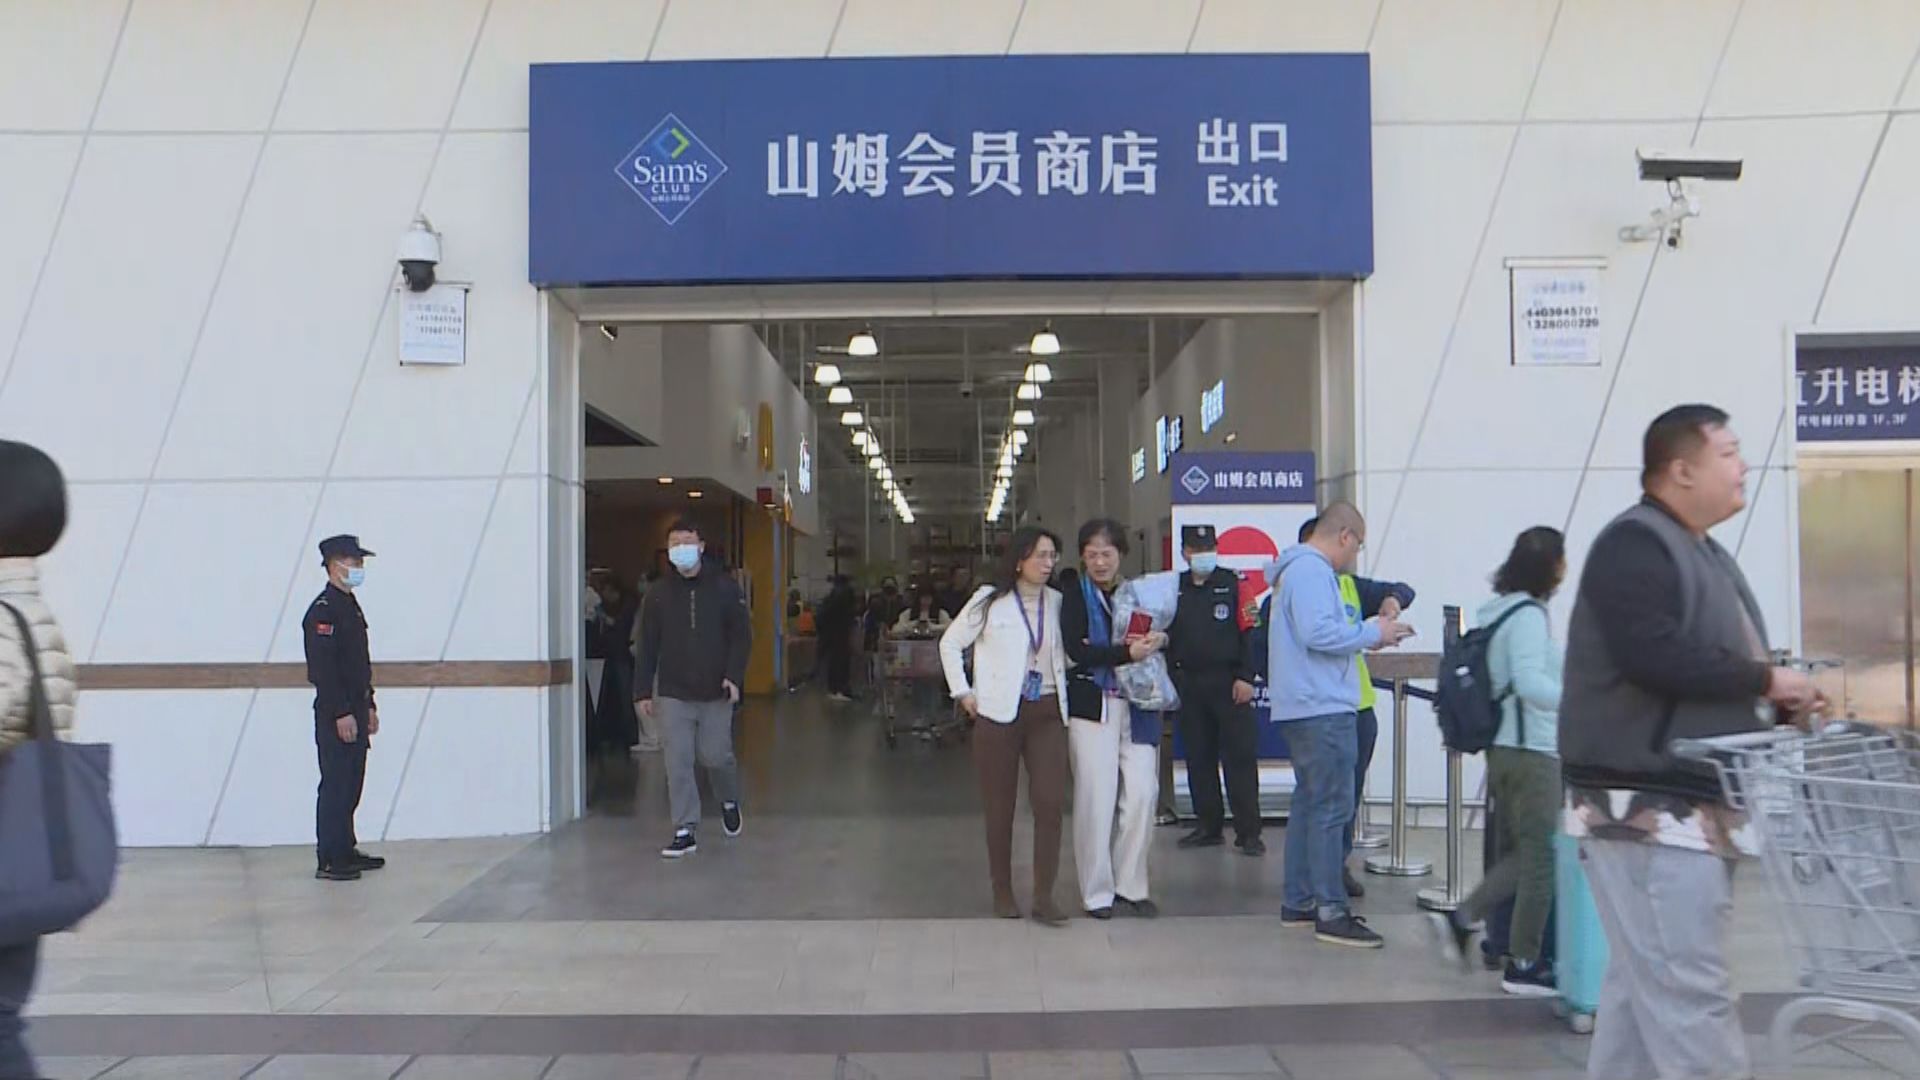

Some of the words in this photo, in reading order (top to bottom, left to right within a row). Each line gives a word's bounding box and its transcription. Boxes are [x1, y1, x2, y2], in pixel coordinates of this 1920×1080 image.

[1197, 119, 1289, 166] 出口
[633, 155, 708, 185] Sam's
[766, 131, 1158, 198] 山姆会员商店
[651, 184, 691, 194] CLUB
[1206, 175, 1279, 207] Exit
[1213, 471, 1304, 488] 山姆会员商店
